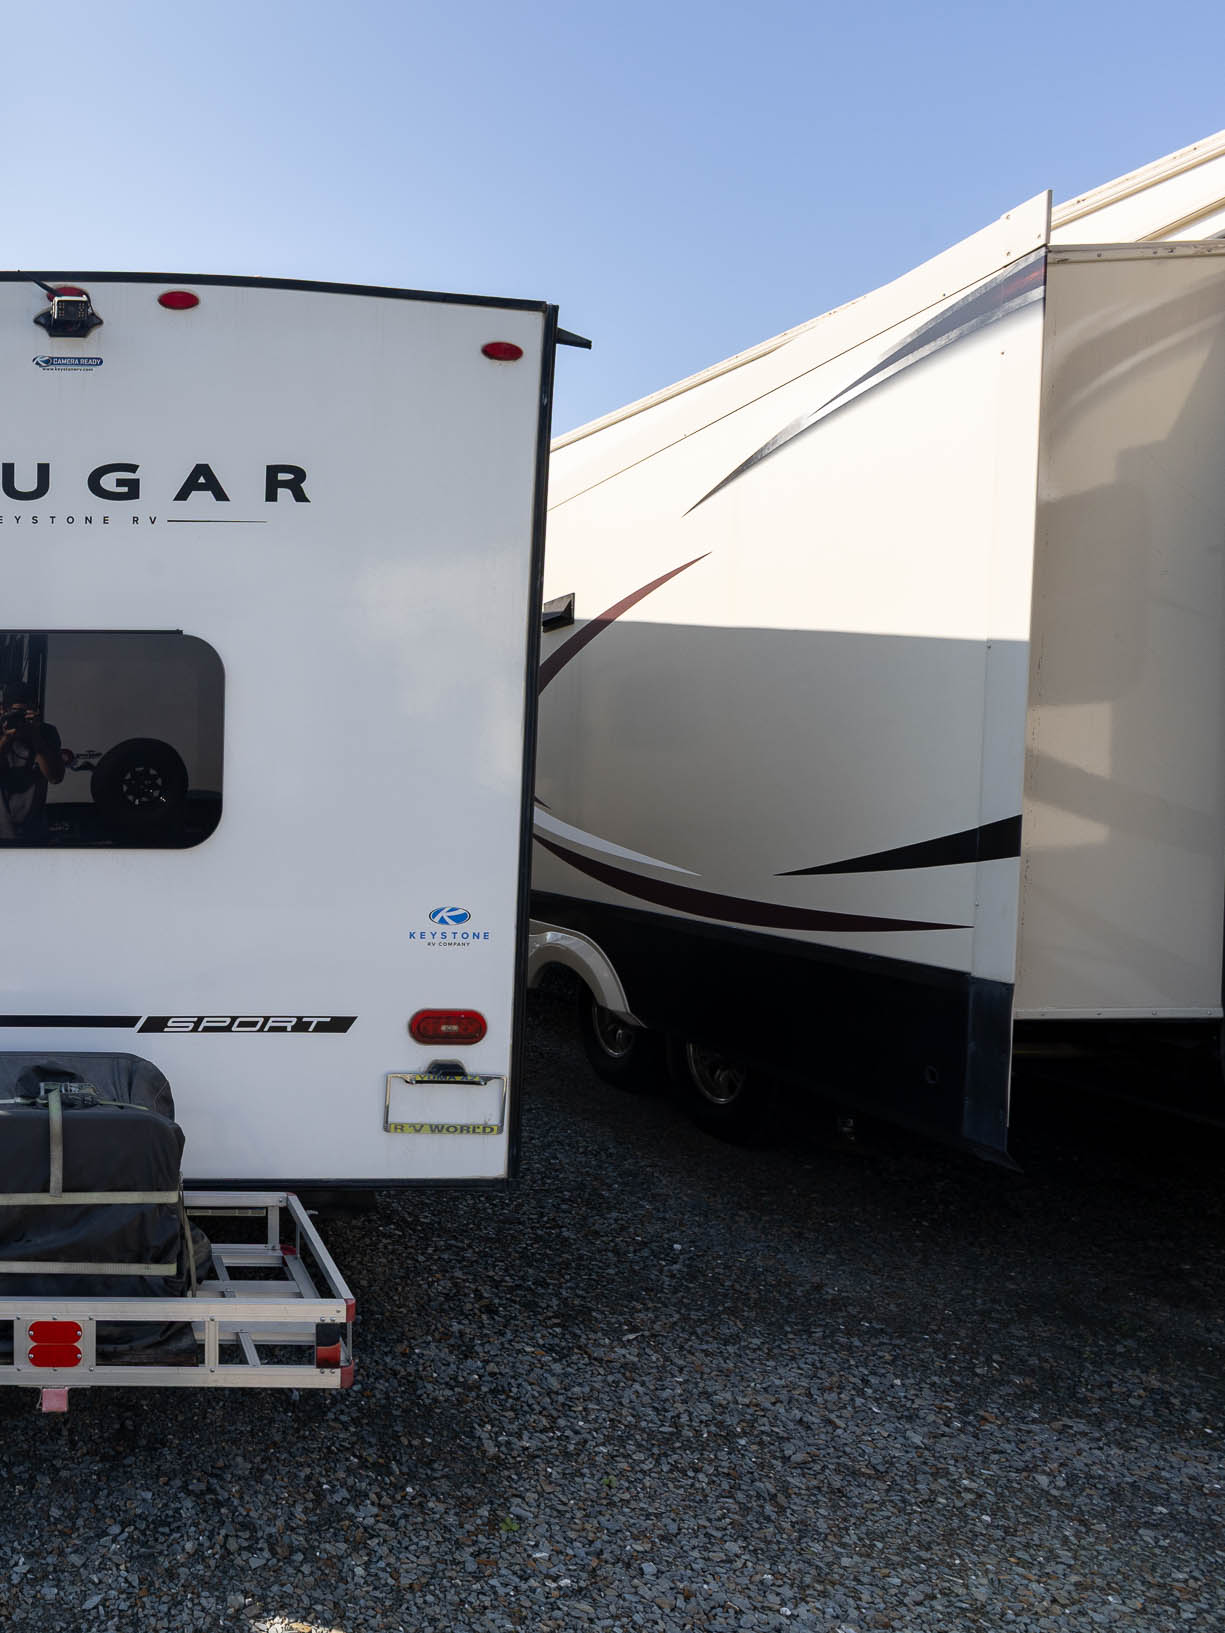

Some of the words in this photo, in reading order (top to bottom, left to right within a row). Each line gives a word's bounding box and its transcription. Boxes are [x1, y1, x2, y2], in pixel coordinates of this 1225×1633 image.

[80, 358, 101, 366] READY
[132, 516, 158, 526] RV
[409, 931, 490, 940] KEYSTONE
[163, 1017, 331, 1032] SPORT
[429, 1124, 494, 1134] WORLD
